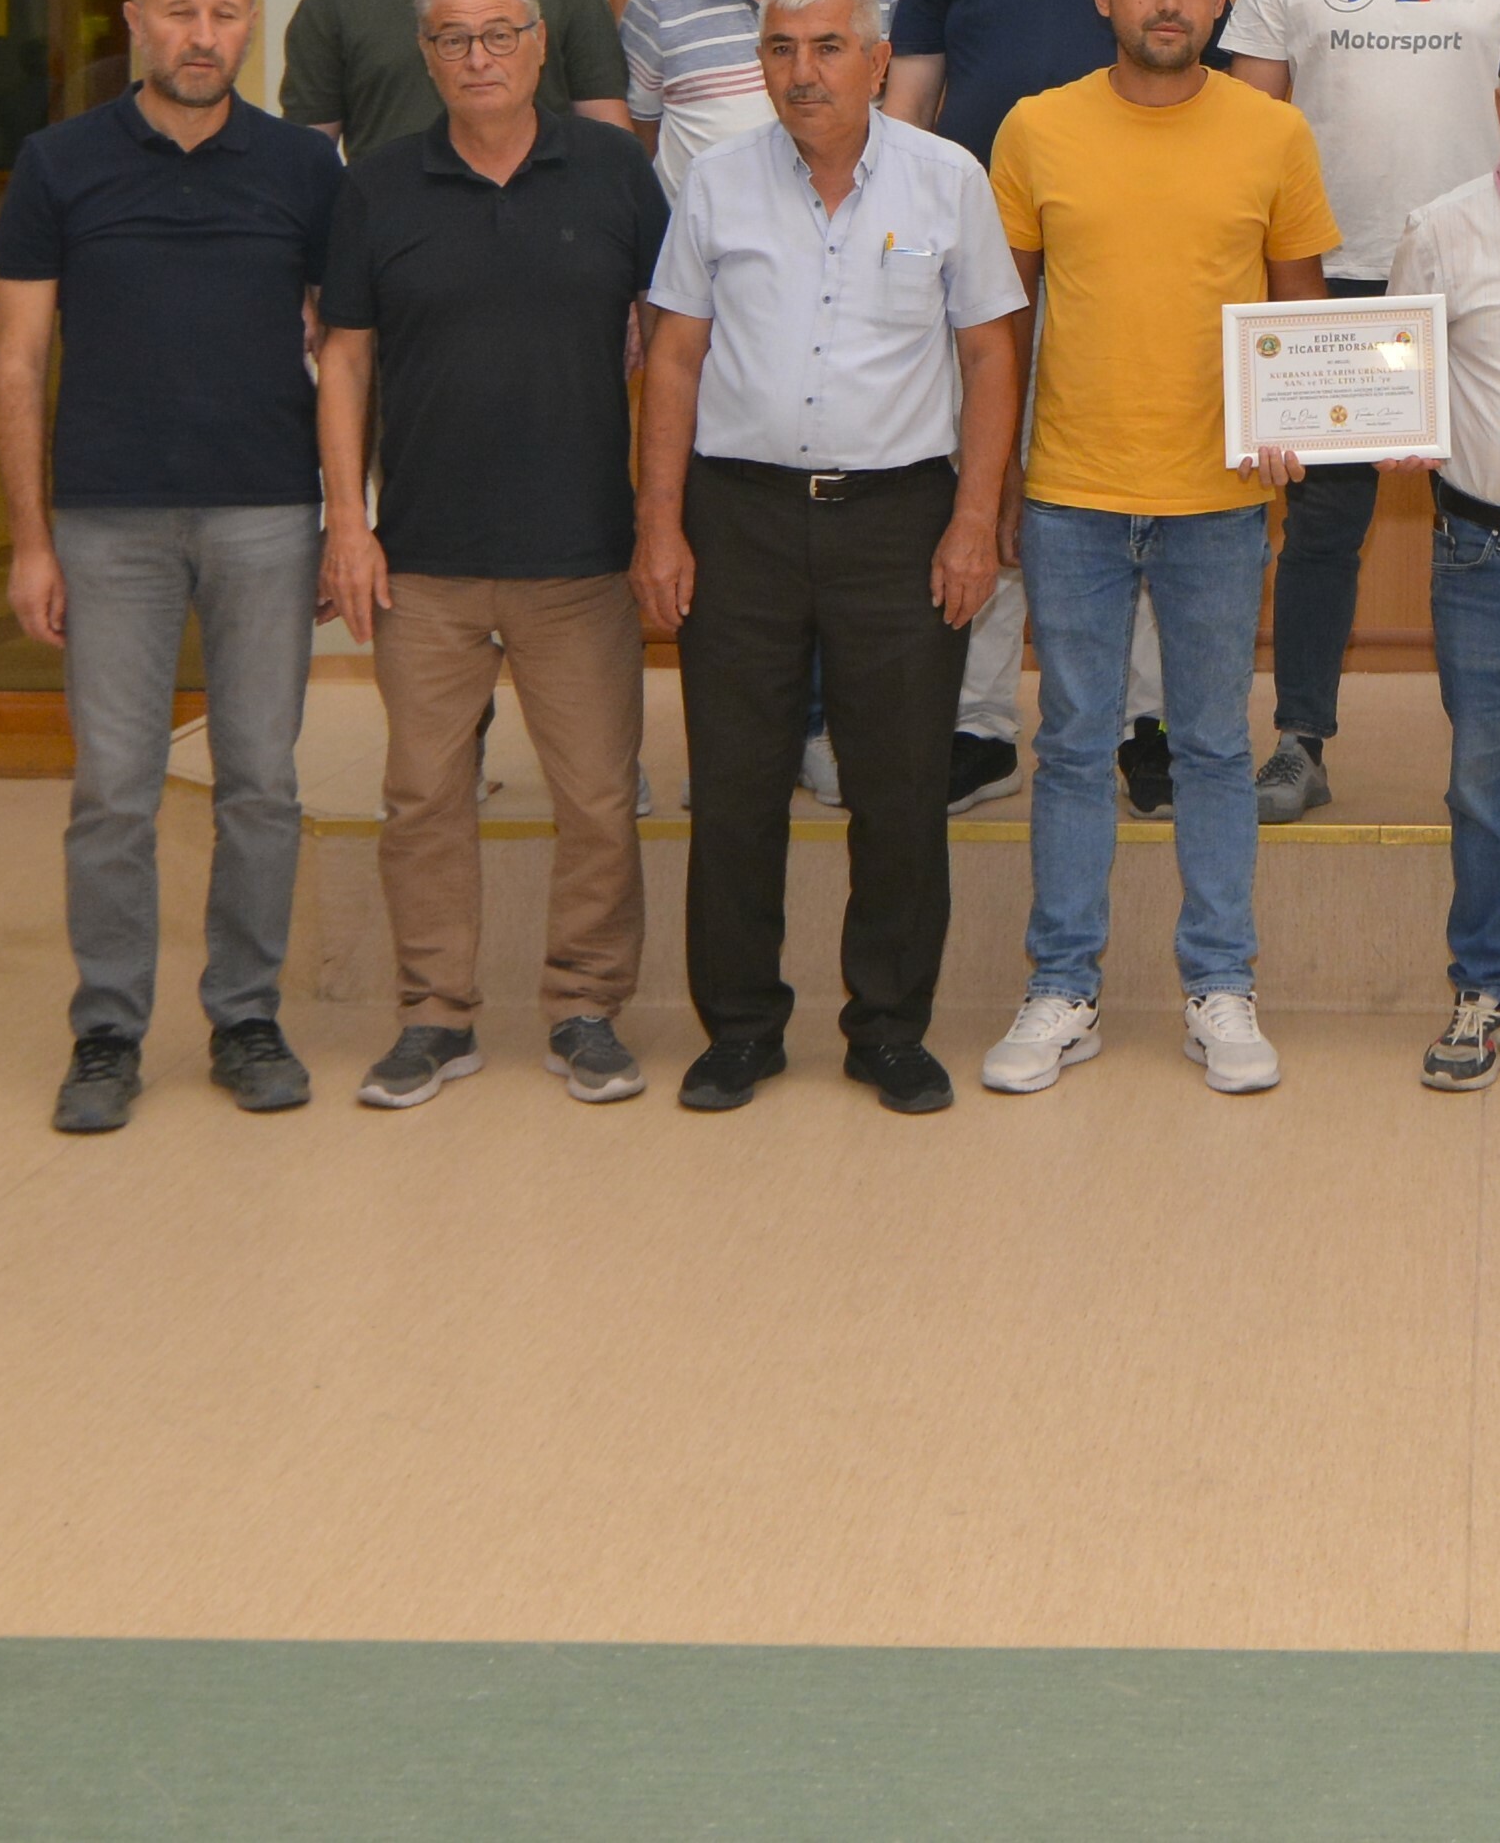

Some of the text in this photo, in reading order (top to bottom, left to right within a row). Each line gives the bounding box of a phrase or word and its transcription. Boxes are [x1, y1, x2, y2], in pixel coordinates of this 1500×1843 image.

[1331, 29, 1462, 54] Motorsport
[1314, 333, 1356, 343] EDİRNE
[1288, 344, 1334, 354] TİCARET
